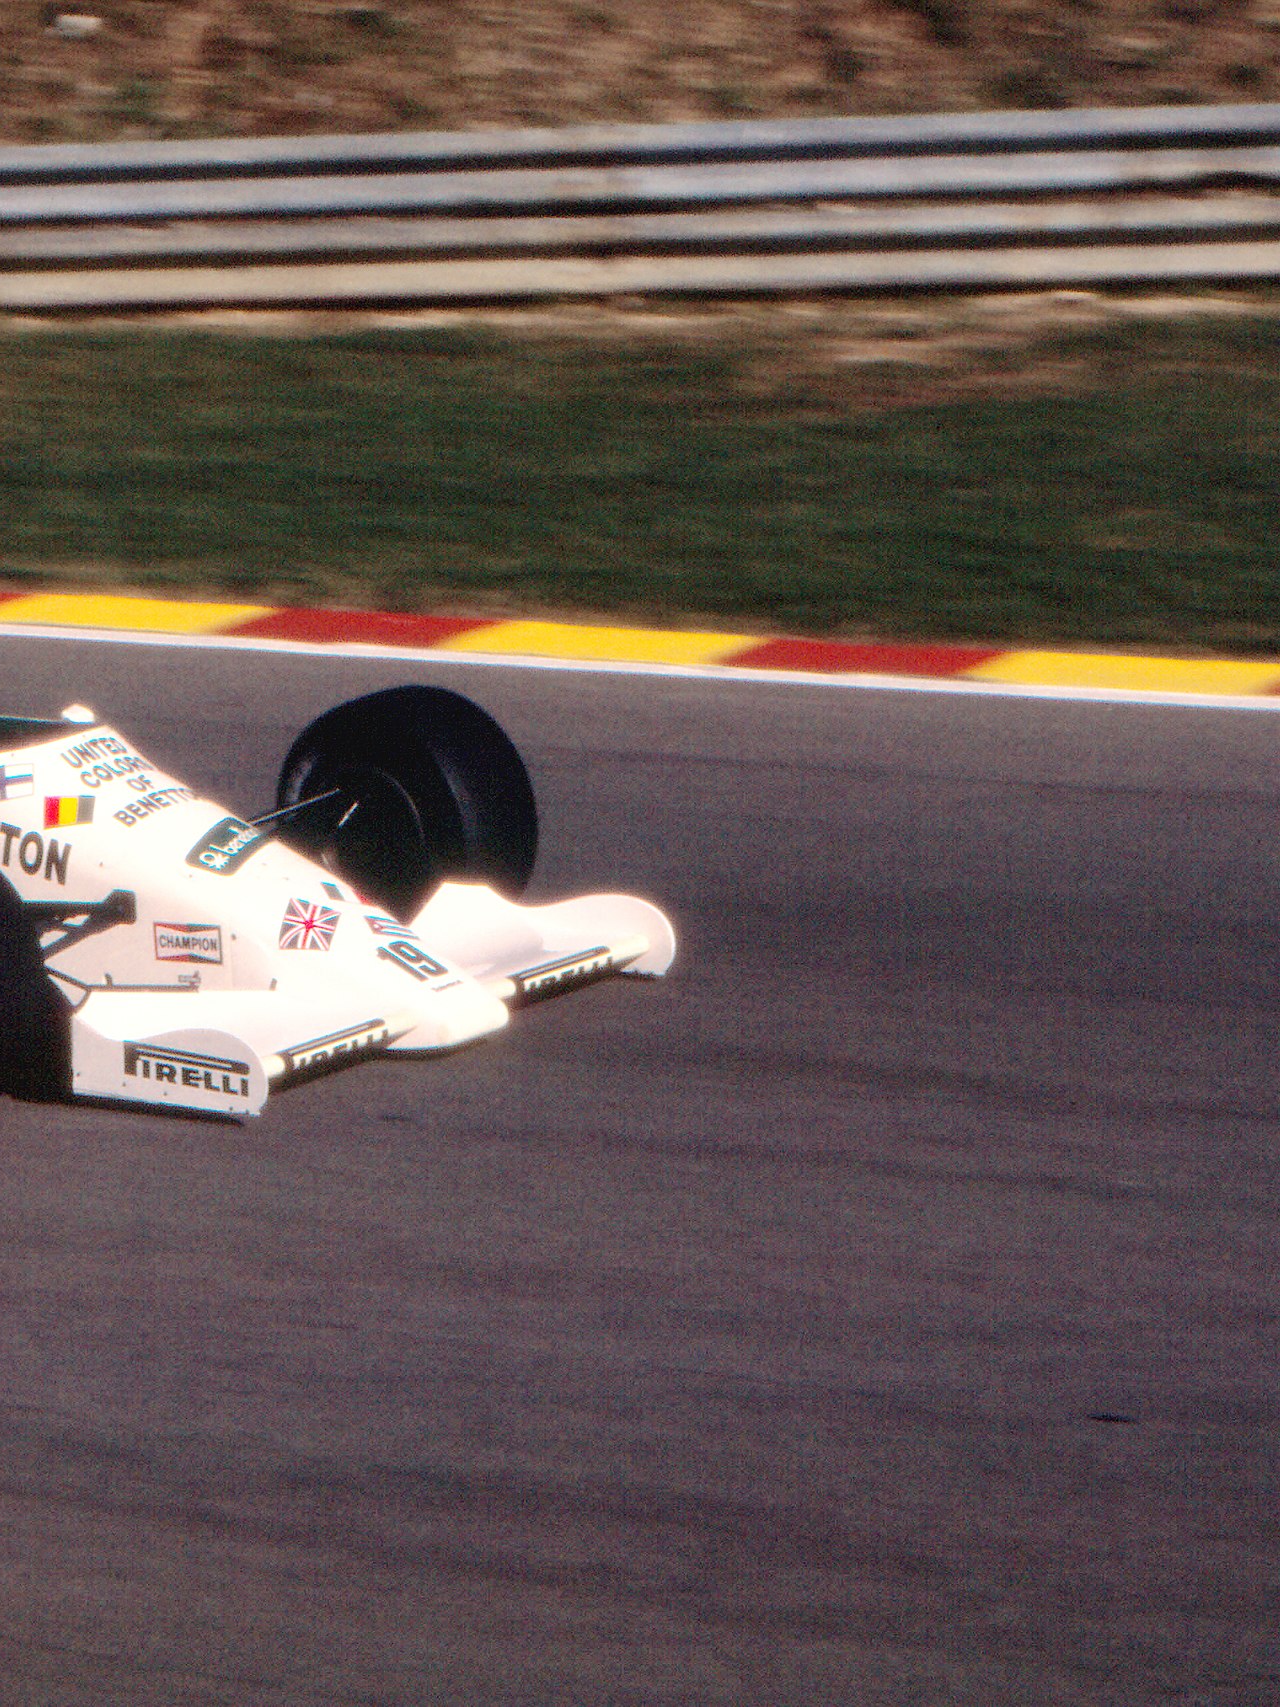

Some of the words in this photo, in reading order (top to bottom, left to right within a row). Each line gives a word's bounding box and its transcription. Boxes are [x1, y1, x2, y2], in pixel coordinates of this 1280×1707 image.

[126, 774, 155, 793] OF
[158, 933, 218, 952] CHAMPION
[122, 1039, 250, 1098] PIRELLI
